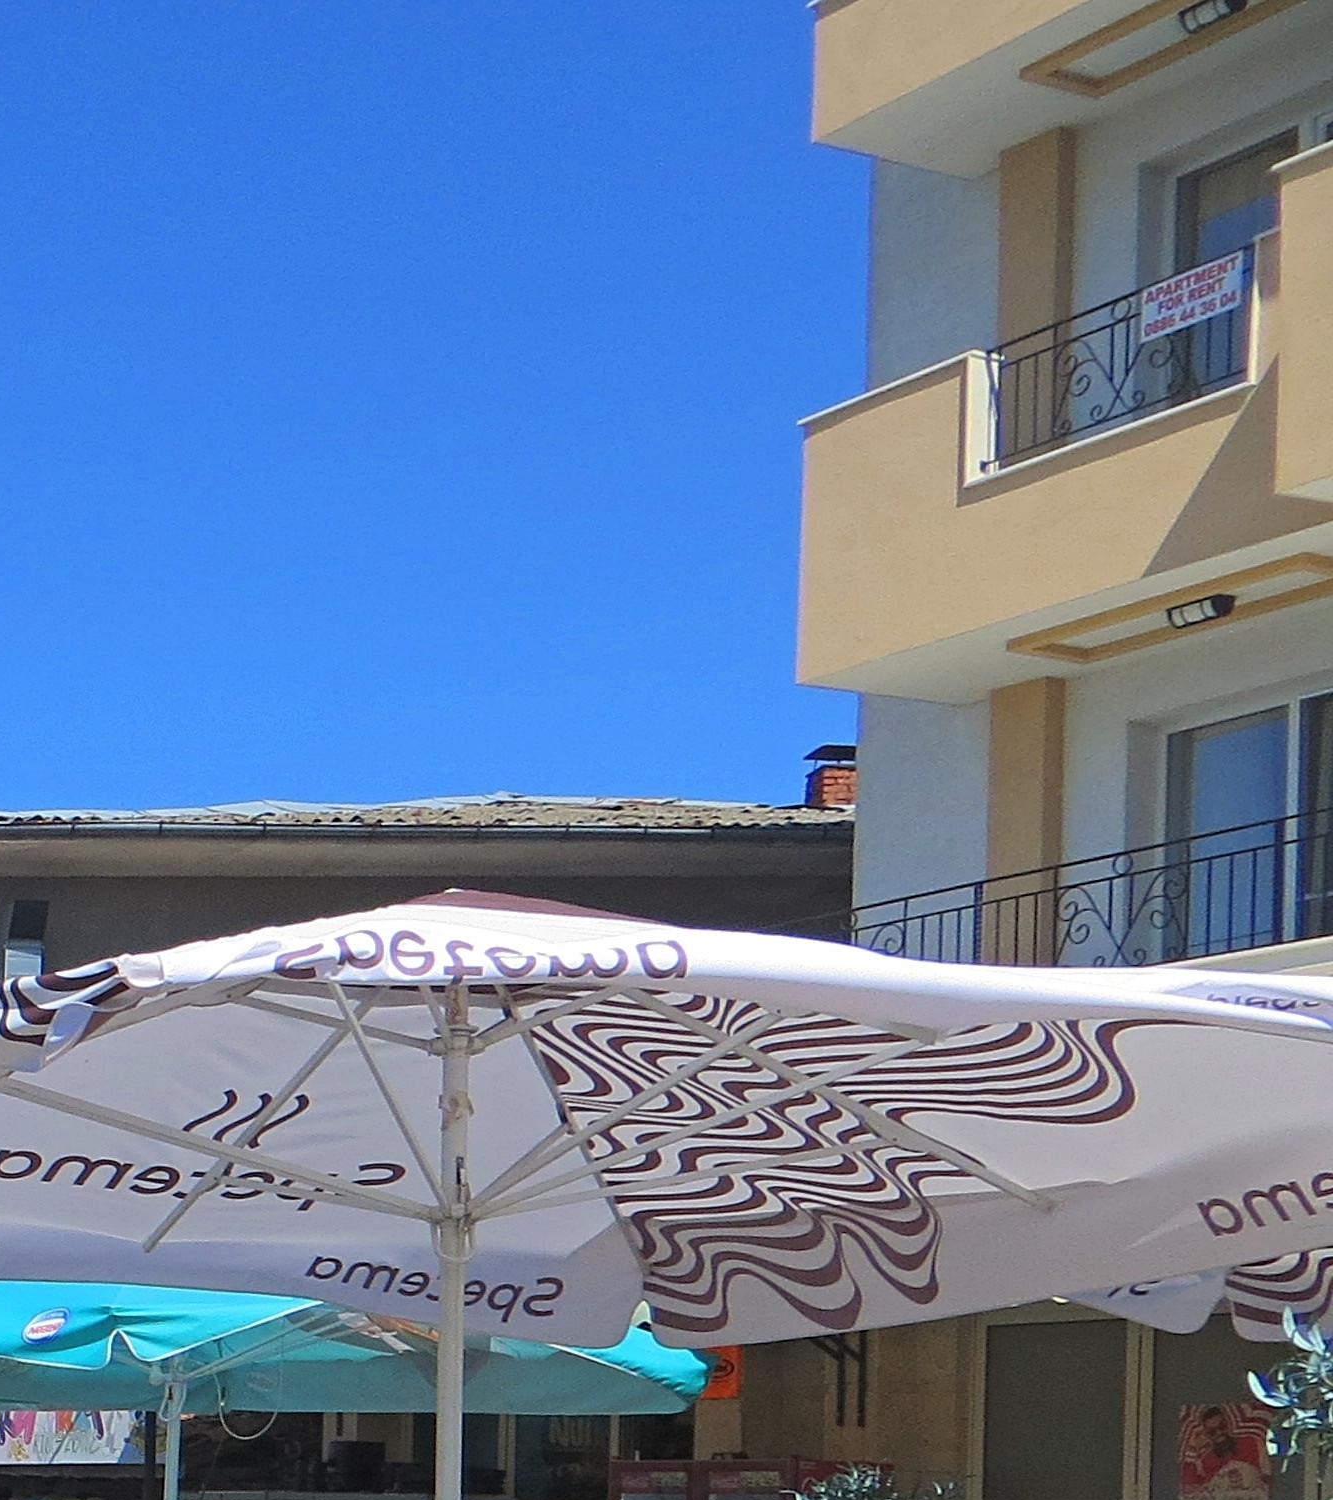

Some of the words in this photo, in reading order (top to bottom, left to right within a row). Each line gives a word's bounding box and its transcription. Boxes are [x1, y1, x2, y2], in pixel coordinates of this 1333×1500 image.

[1144, 256, 1238, 304] APARTMENT
[1158, 293, 1184, 314] FOR
[1187, 276, 1226, 302] RENT
